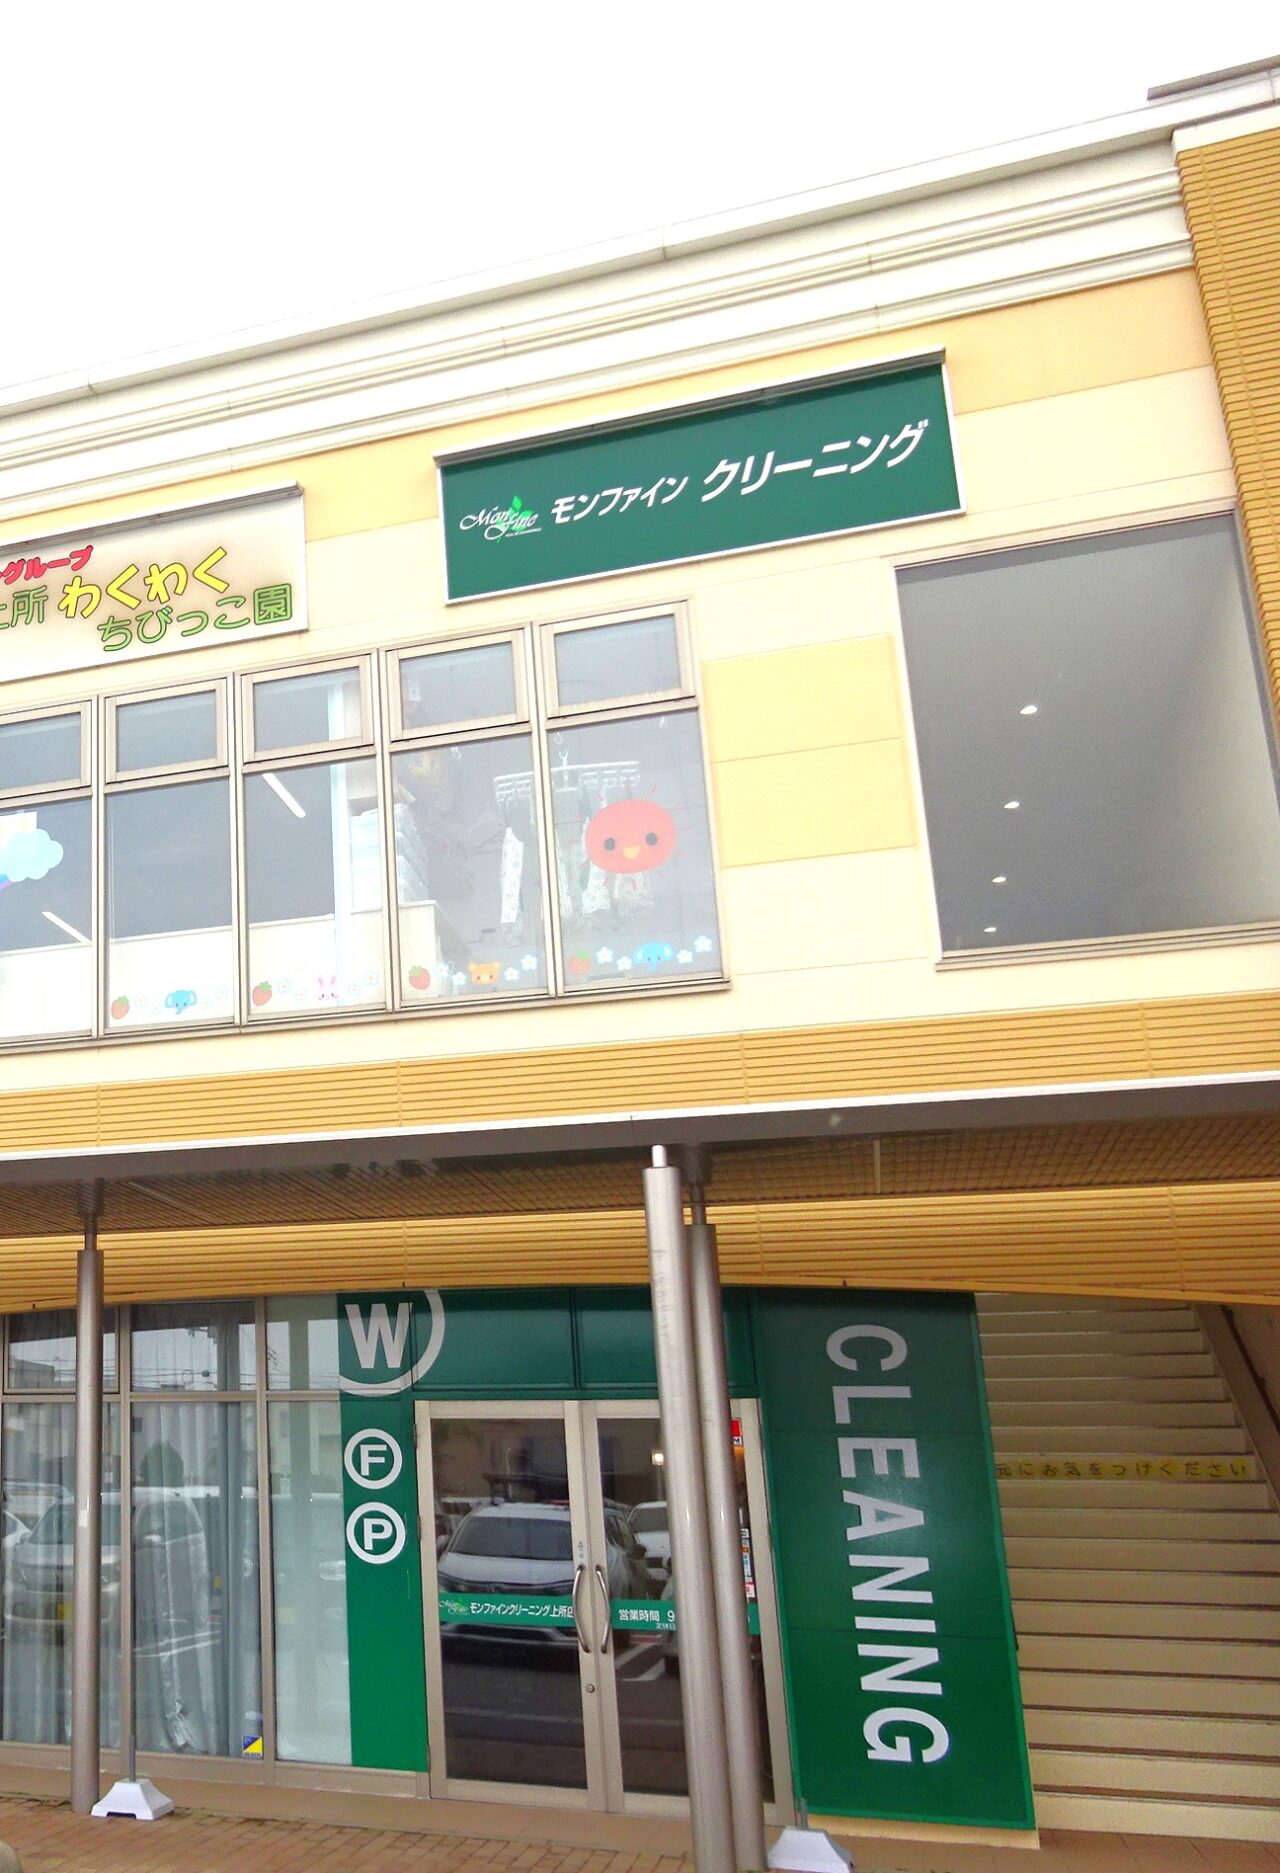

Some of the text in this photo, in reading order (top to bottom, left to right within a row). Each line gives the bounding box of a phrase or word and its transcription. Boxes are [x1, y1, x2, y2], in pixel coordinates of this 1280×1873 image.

[551, 419, 929, 524] モンファイン クリーニング
[58, 546, 227, 619] わくわく
[98, 583, 292, 652] ちびっこ園
[345, 1303, 412, 1368] W
[360, 1444, 387, 1476] F
[363, 1517, 393, 1551] P
[826, 1324, 950, 1763] CLEANING
[470, 1602, 549, 1615] モンファインクリーニング
[618, 1608, 660, 1622] 営業時間
